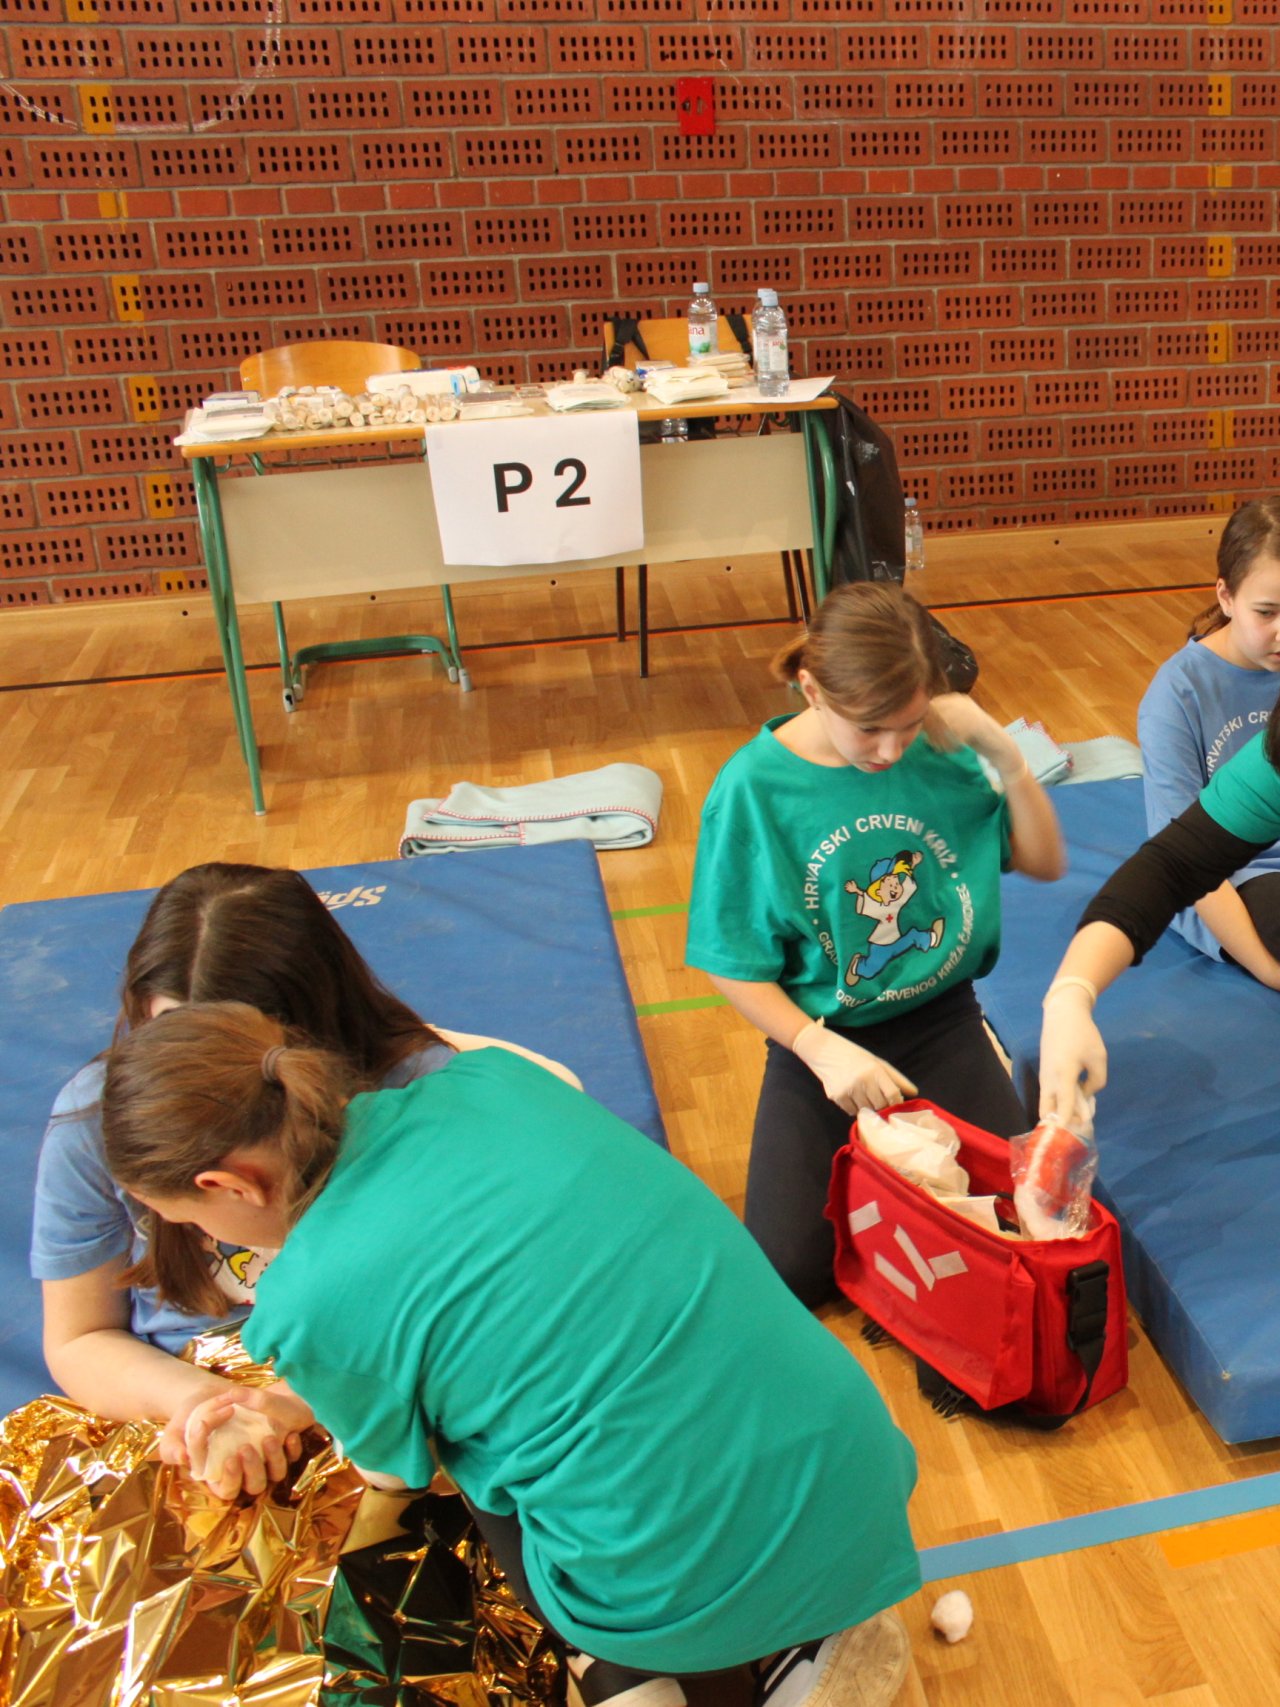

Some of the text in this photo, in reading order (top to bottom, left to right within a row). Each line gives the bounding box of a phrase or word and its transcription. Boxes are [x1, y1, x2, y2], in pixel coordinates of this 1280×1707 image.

[493, 457, 591, 513] P 2
[804, 826, 851, 909] HRVATSKI
[855, 814, 925, 835] CRVENI
